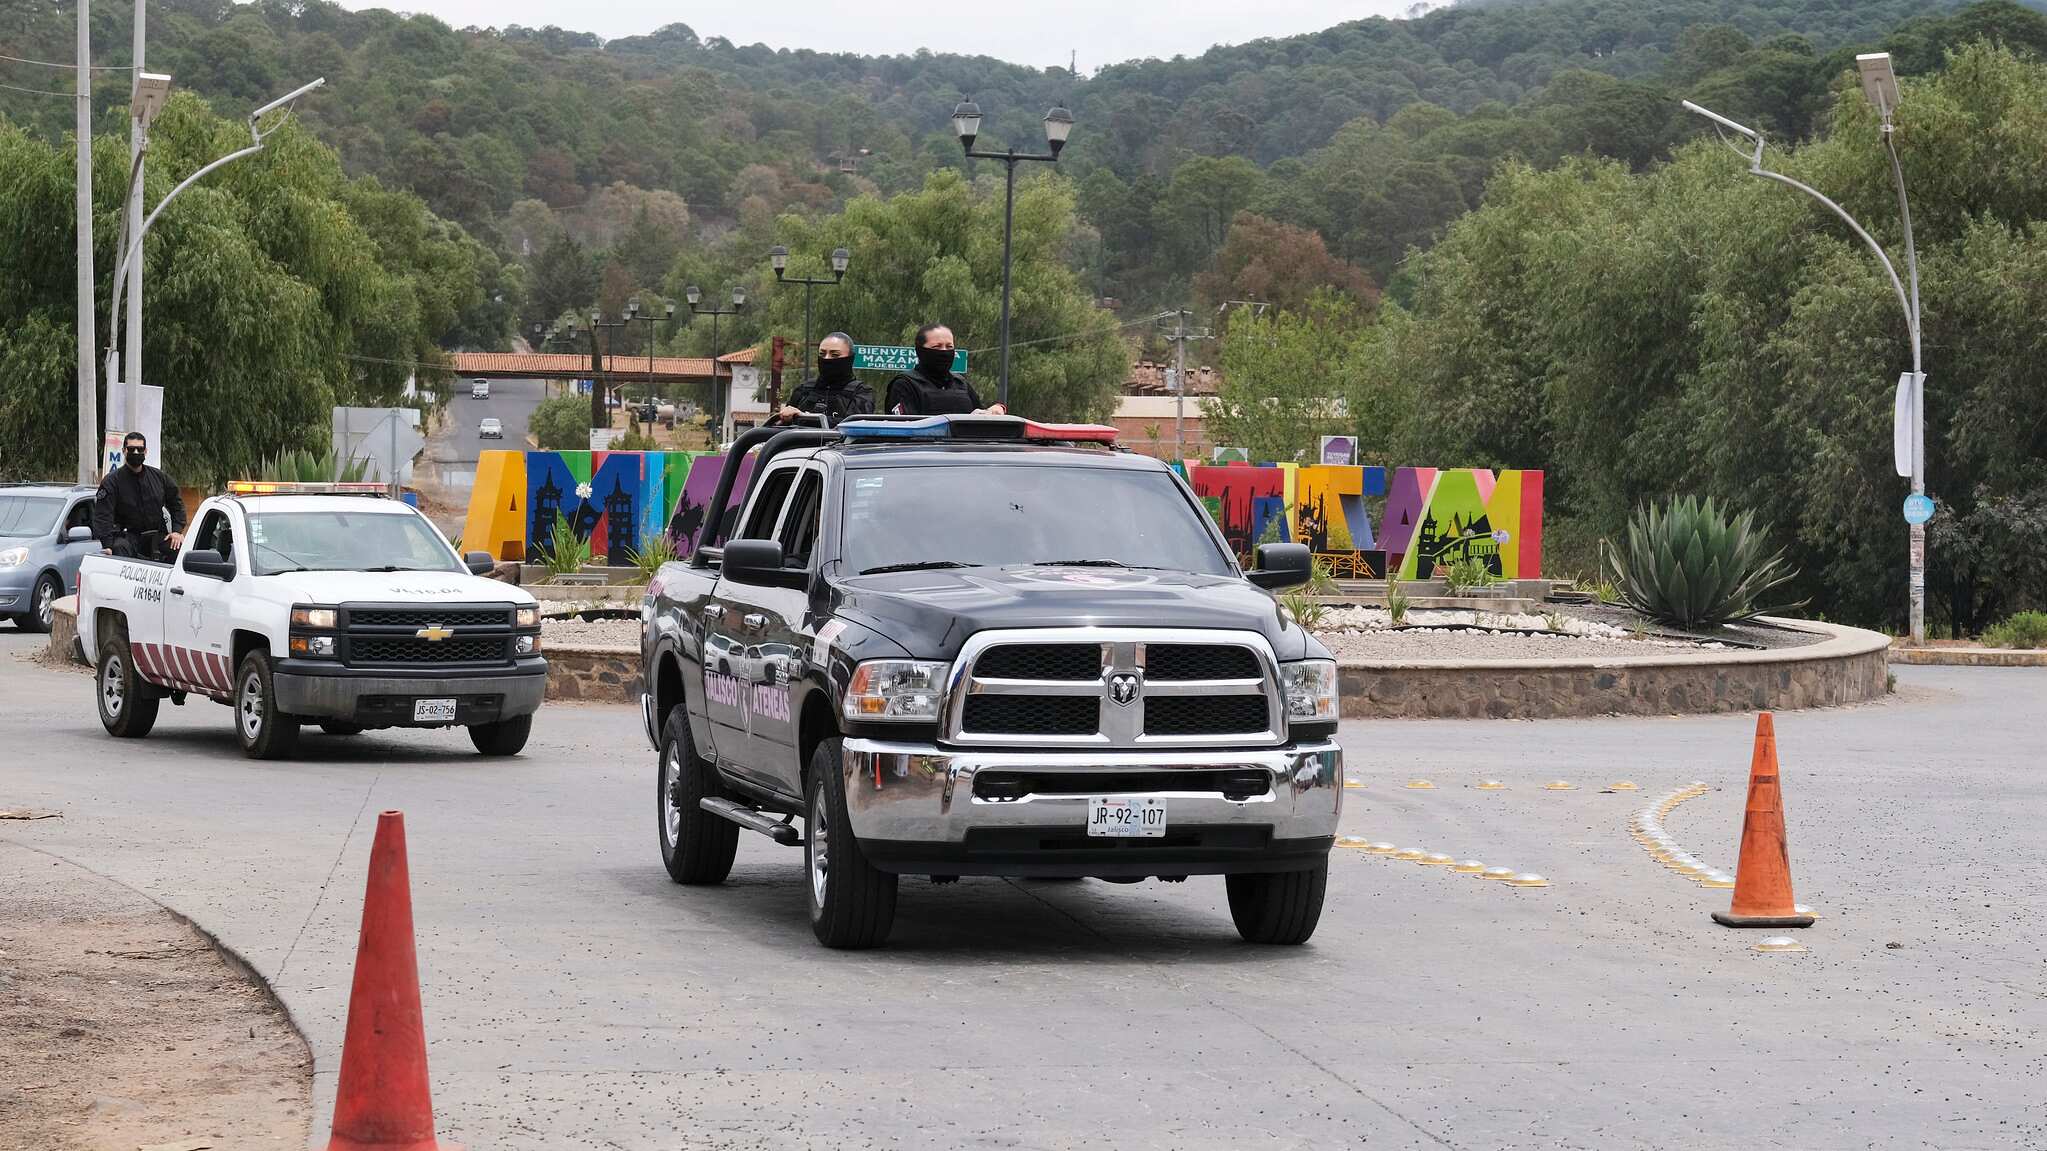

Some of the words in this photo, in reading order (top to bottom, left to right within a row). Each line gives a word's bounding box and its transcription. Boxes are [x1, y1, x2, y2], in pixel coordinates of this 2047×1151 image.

[120, 565, 148, 583] POLICIA
[148, 570, 165, 586] VIAL
[133, 586, 161, 602] VR16-04
[705, 672, 738, 707] JALISCO
[416, 705, 455, 715] JS-02-756
[753, 683, 790, 723] ATENEAS
[1092, 807, 1164, 825] JR-92-107
[1107, 825, 1129, 833] Jalisco
